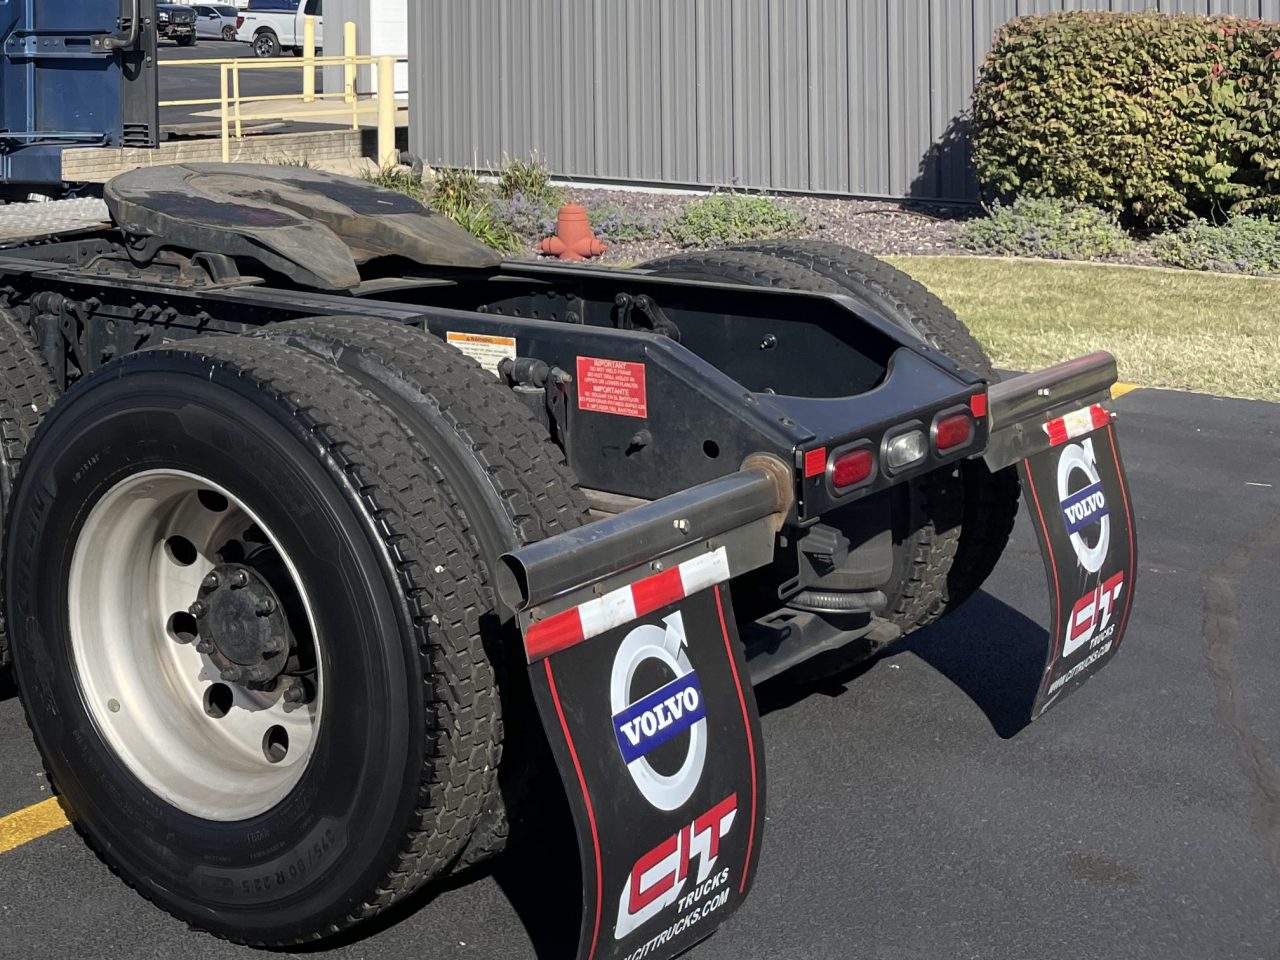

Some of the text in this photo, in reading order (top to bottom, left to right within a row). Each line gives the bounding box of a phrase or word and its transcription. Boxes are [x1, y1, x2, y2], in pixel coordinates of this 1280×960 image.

[1064, 491, 1105, 525] VOLVO
[1062, 570, 1124, 658] CIT
[620, 686, 699, 746] VOLVO
[614, 792, 737, 940] CIT
[678, 867, 729, 914] TRUCKS
